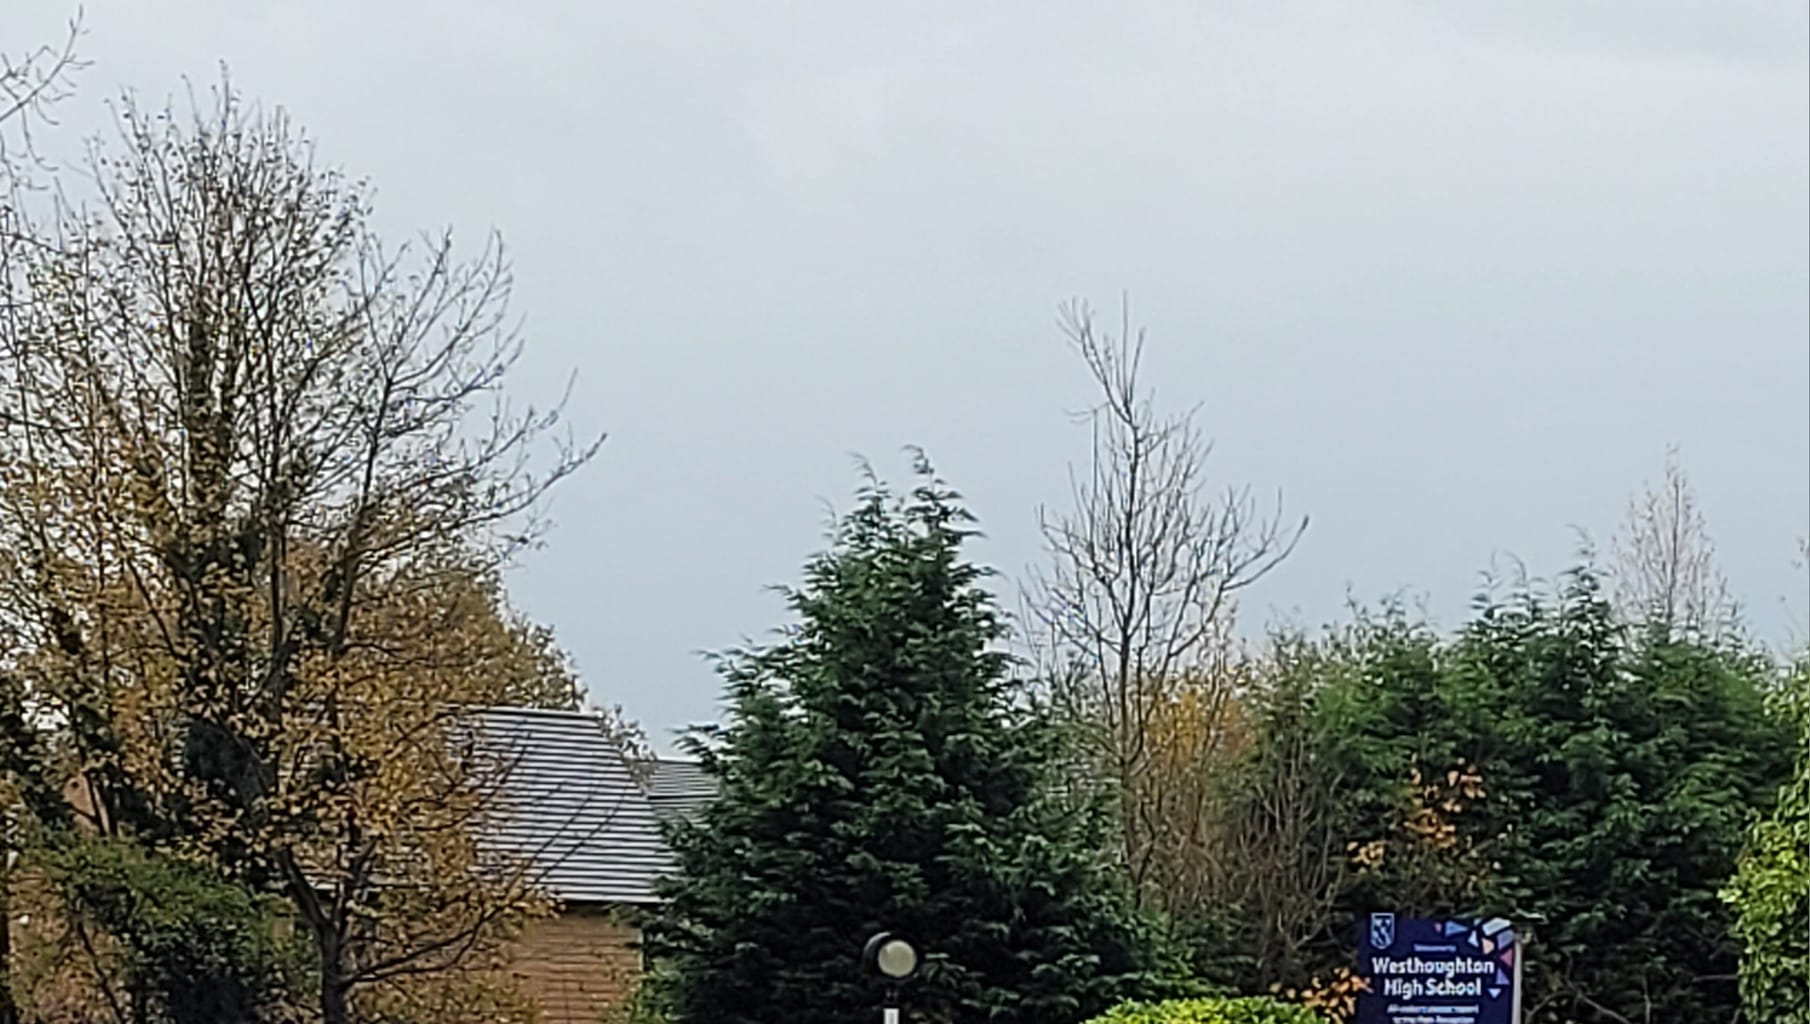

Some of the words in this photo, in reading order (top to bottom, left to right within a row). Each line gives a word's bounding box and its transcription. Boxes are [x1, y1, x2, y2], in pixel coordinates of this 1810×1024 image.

[1372, 957, 1495, 978] Westhoughton
[1384, 978, 1423, 1000] High
[1426, 977, 1482, 996] School
